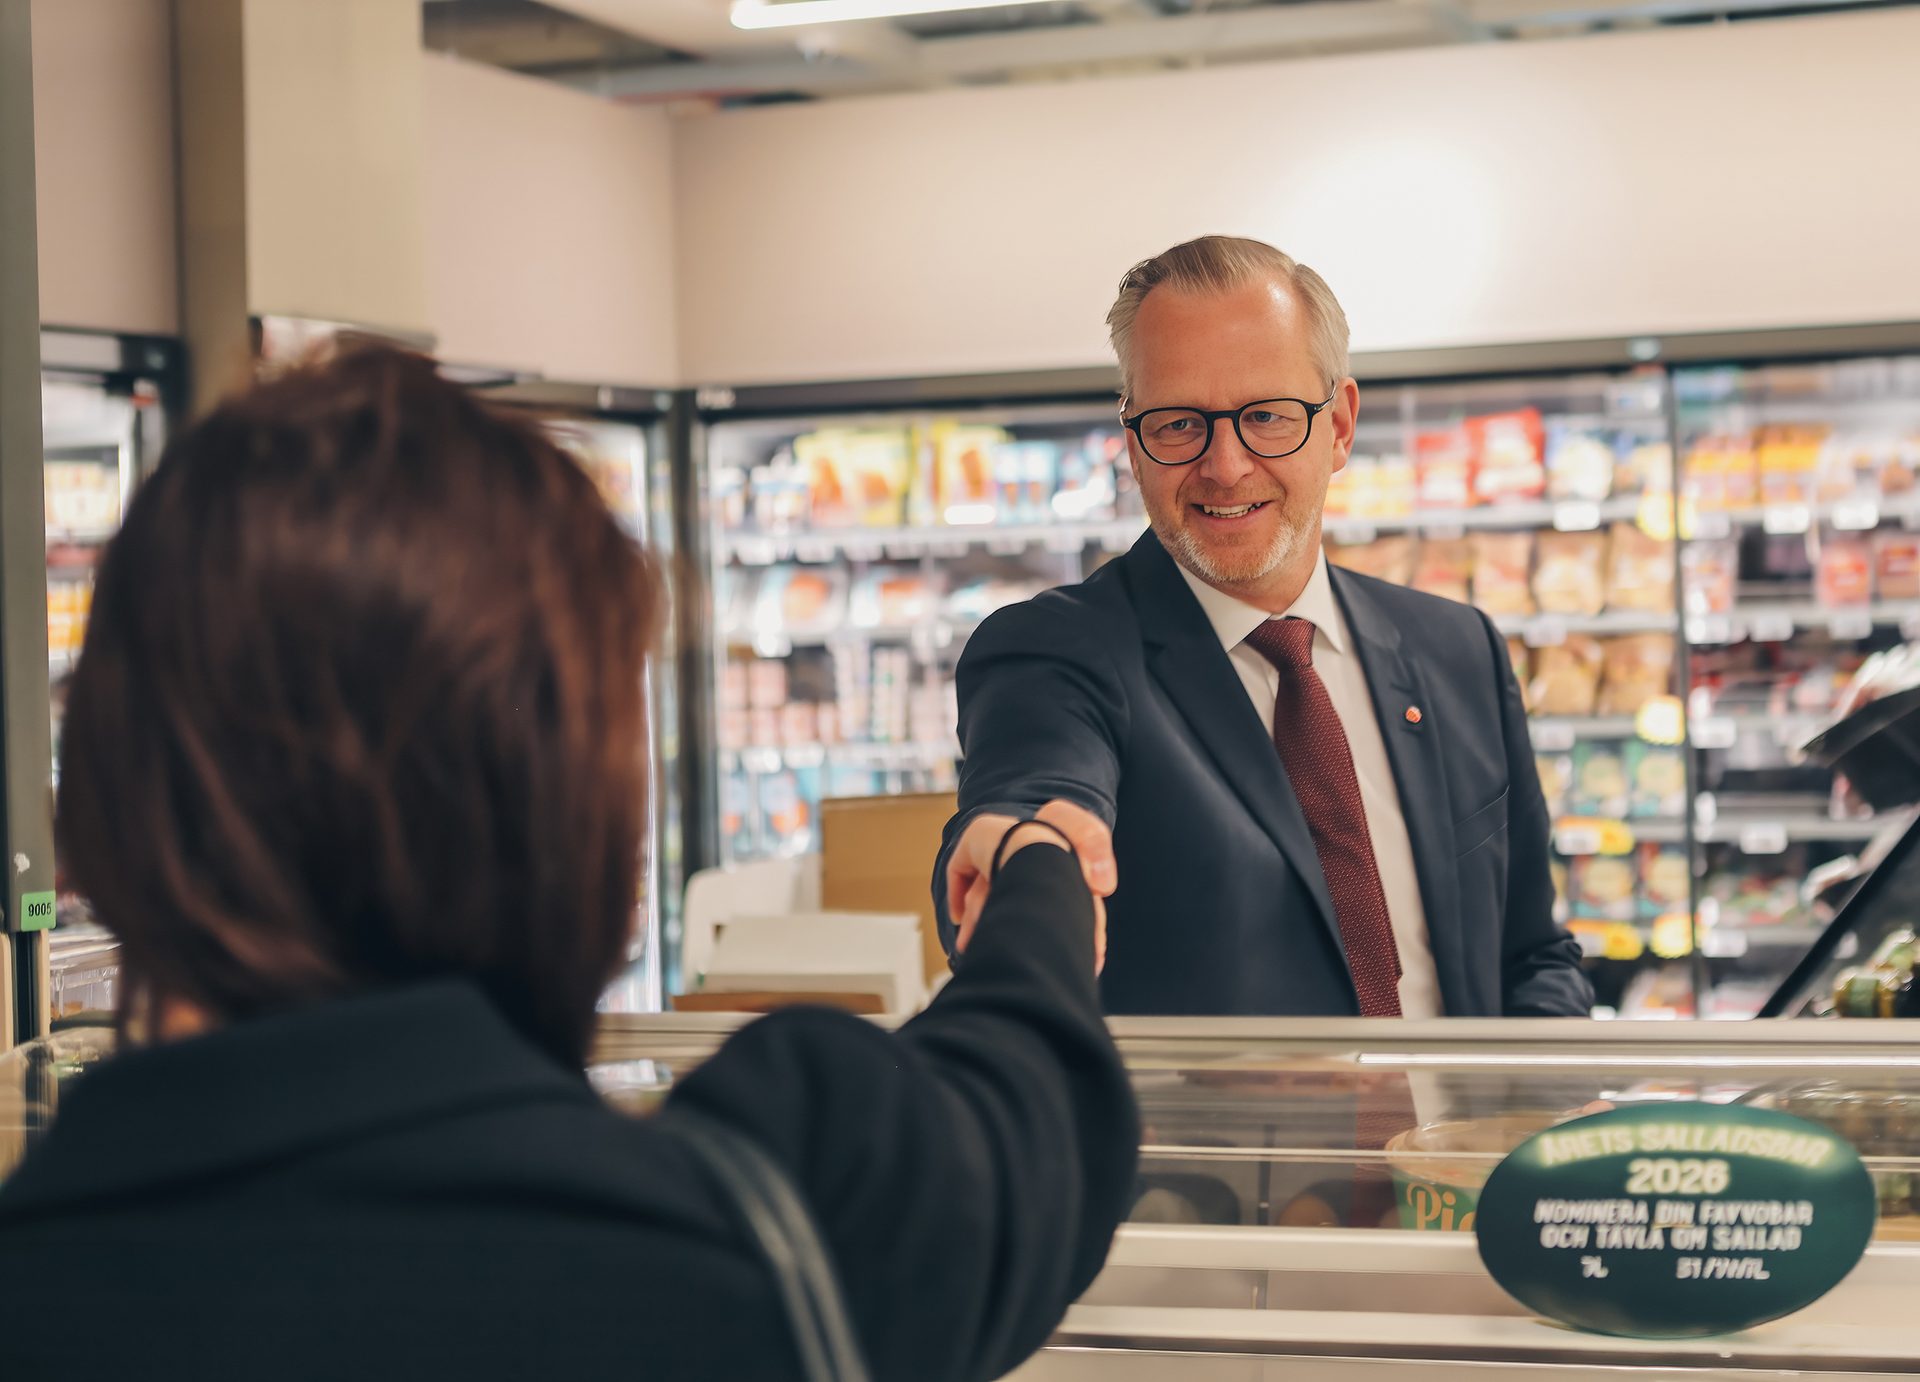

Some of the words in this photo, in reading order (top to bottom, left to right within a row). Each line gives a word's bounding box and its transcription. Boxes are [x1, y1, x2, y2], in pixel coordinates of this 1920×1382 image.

[1638, 1121, 1834, 1168] SALLADSBAR
[1625, 1157, 1731, 1195] 2026
[1534, 1199, 1649, 1224] NOMINERA
[1654, 1200, 1696, 1224] DIN
[1699, 1200, 1814, 1226] FAVVOBAR
[1540, 1224, 1590, 1249] OCH
[1671, 1225, 1708, 1251] OM
[1712, 1225, 1802, 1251] SALLAD
